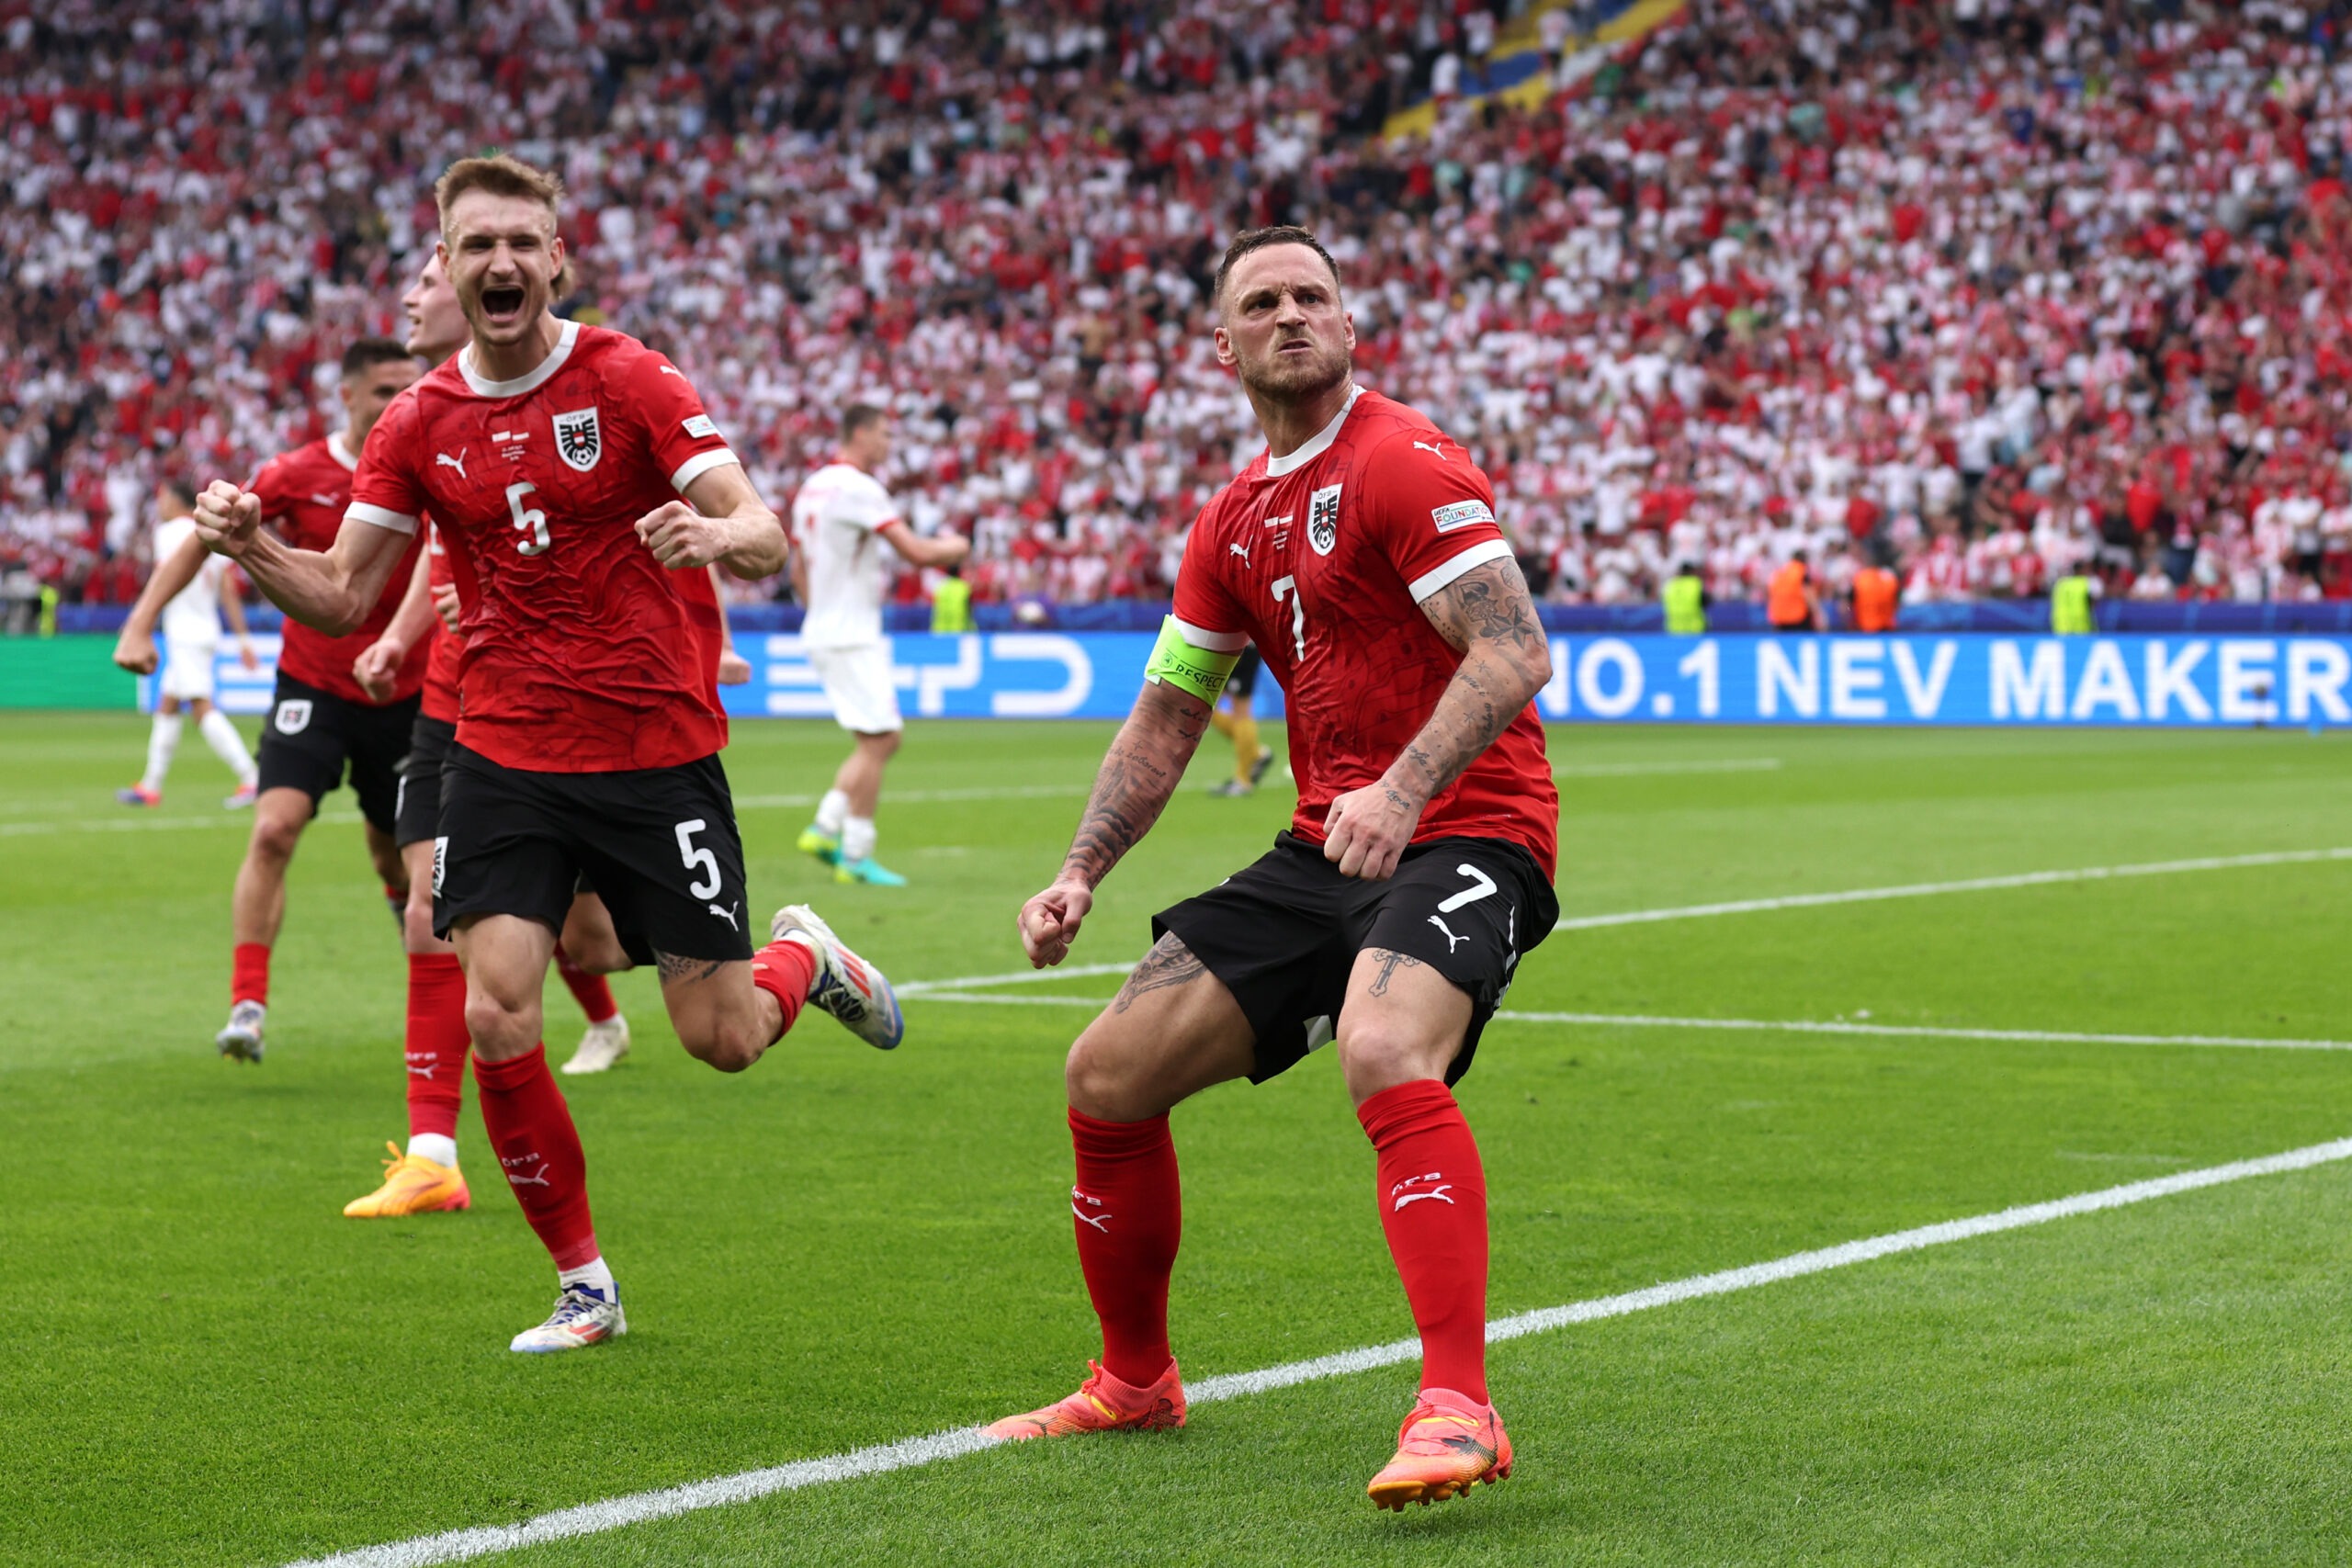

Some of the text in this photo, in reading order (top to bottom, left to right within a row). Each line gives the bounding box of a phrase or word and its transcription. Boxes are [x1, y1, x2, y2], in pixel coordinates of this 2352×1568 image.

[505, 481, 550, 557] 5
[1433, 507, 1450, 516] UEFA
[1435, 506, 1489, 525] FOUNDATIO
[1272, 575, 1305, 661] 7
[1175, 664, 1226, 688] RESPECT
[1756, 639, 1958, 718] NEV
[1990, 638, 2352, 721] MAKER
[675, 818, 721, 900] 5
[1437, 863, 1498, 913] 7
